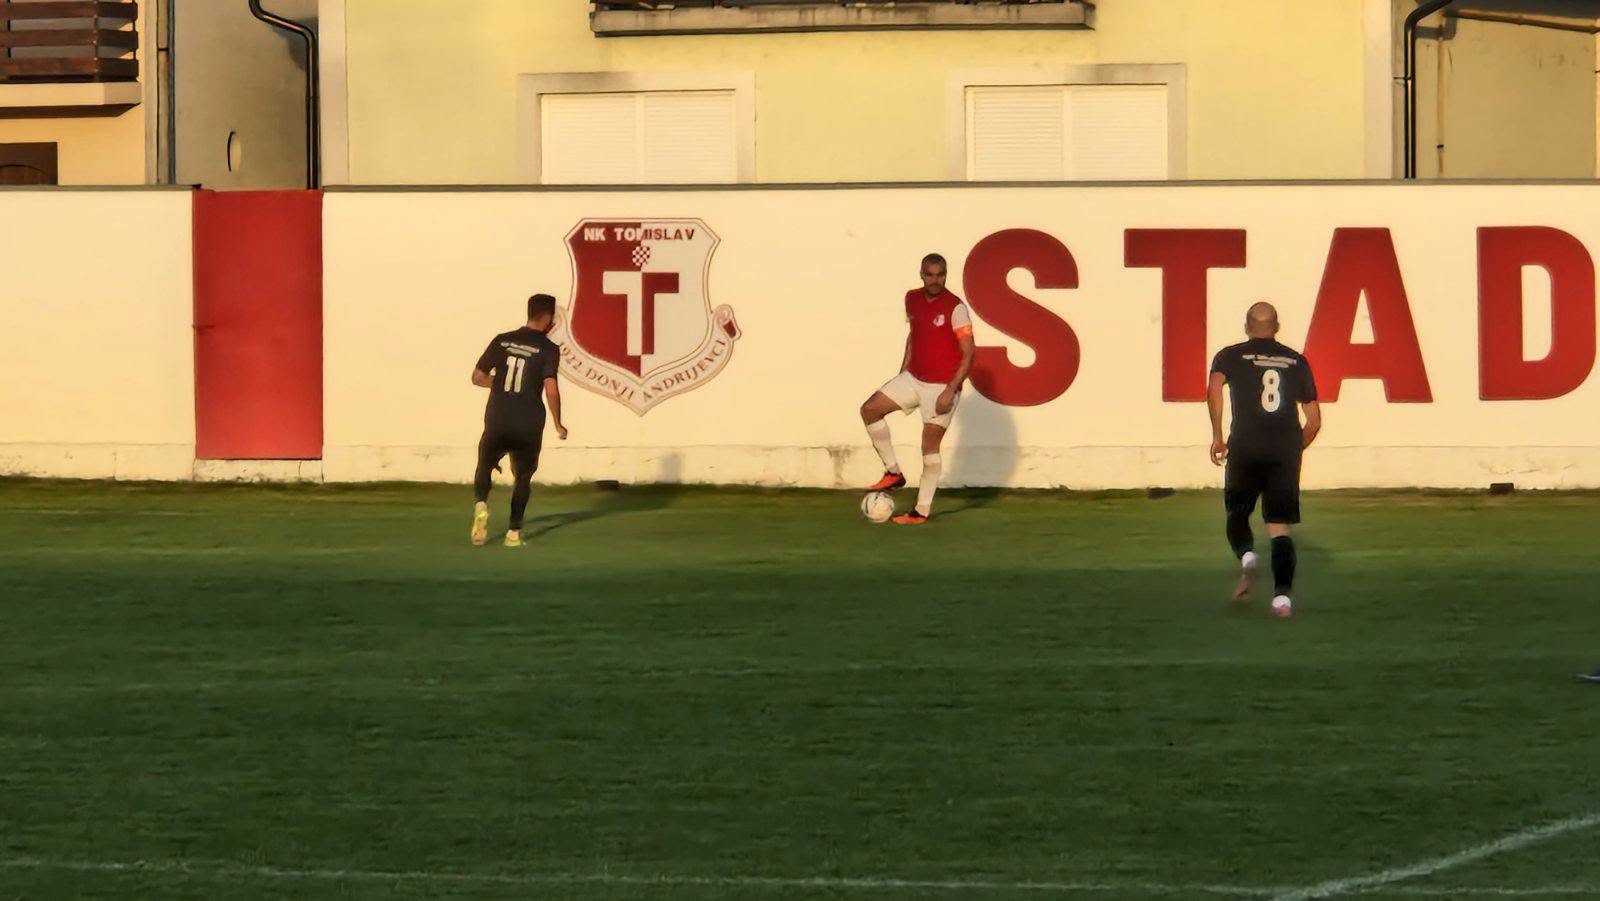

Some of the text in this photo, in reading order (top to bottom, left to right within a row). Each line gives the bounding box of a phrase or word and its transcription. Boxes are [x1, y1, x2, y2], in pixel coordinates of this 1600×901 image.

[584, 227, 696, 241] NK TOMISLAV
[962, 226, 1598, 407] STAD
[504, 355, 526, 393] 11
[585, 367, 635, 402] DONJI
[642, 338, 727, 402] ANDRIJEVCI
[1261, 369, 1281, 413] 8
